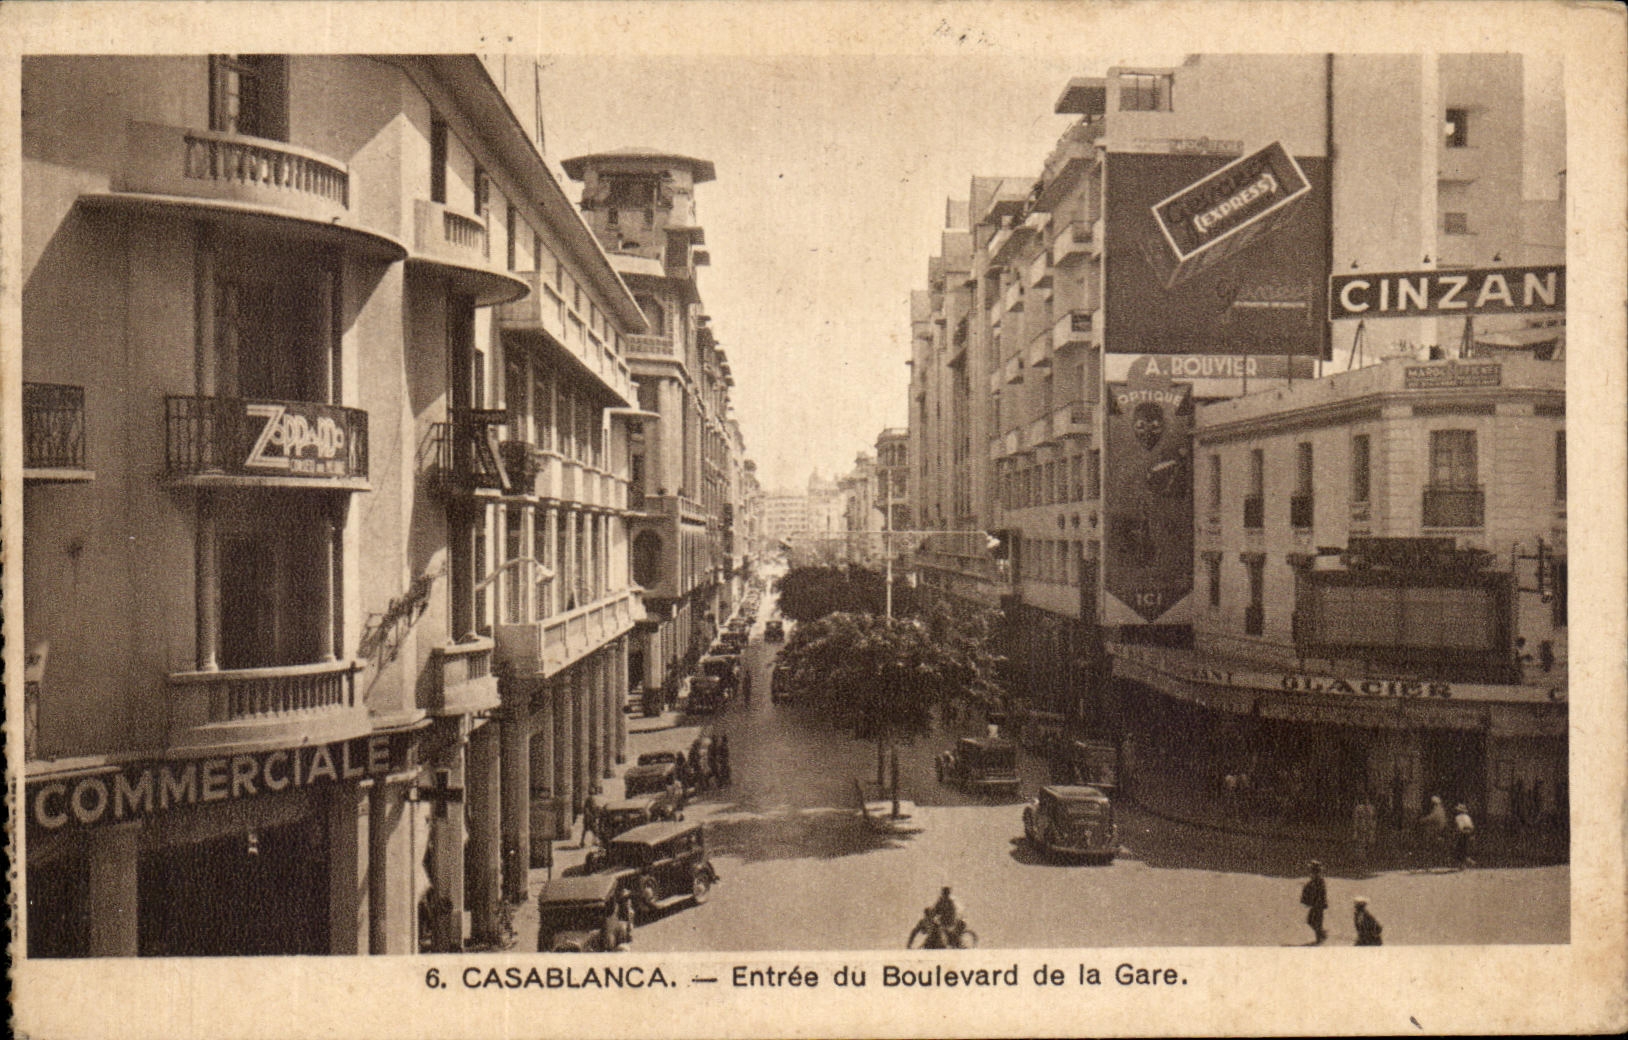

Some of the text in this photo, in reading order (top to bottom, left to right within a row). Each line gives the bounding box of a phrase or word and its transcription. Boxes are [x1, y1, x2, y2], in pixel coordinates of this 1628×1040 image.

[1340, 272, 1557, 313] CINZAN
[1171, 357, 1258, 376] BOUVIER
[1117, 390, 1184, 407] OPTIQUE
[1136, 593, 1161, 606] ICI
[34, 735, 391, 828] COMMERCIALE
